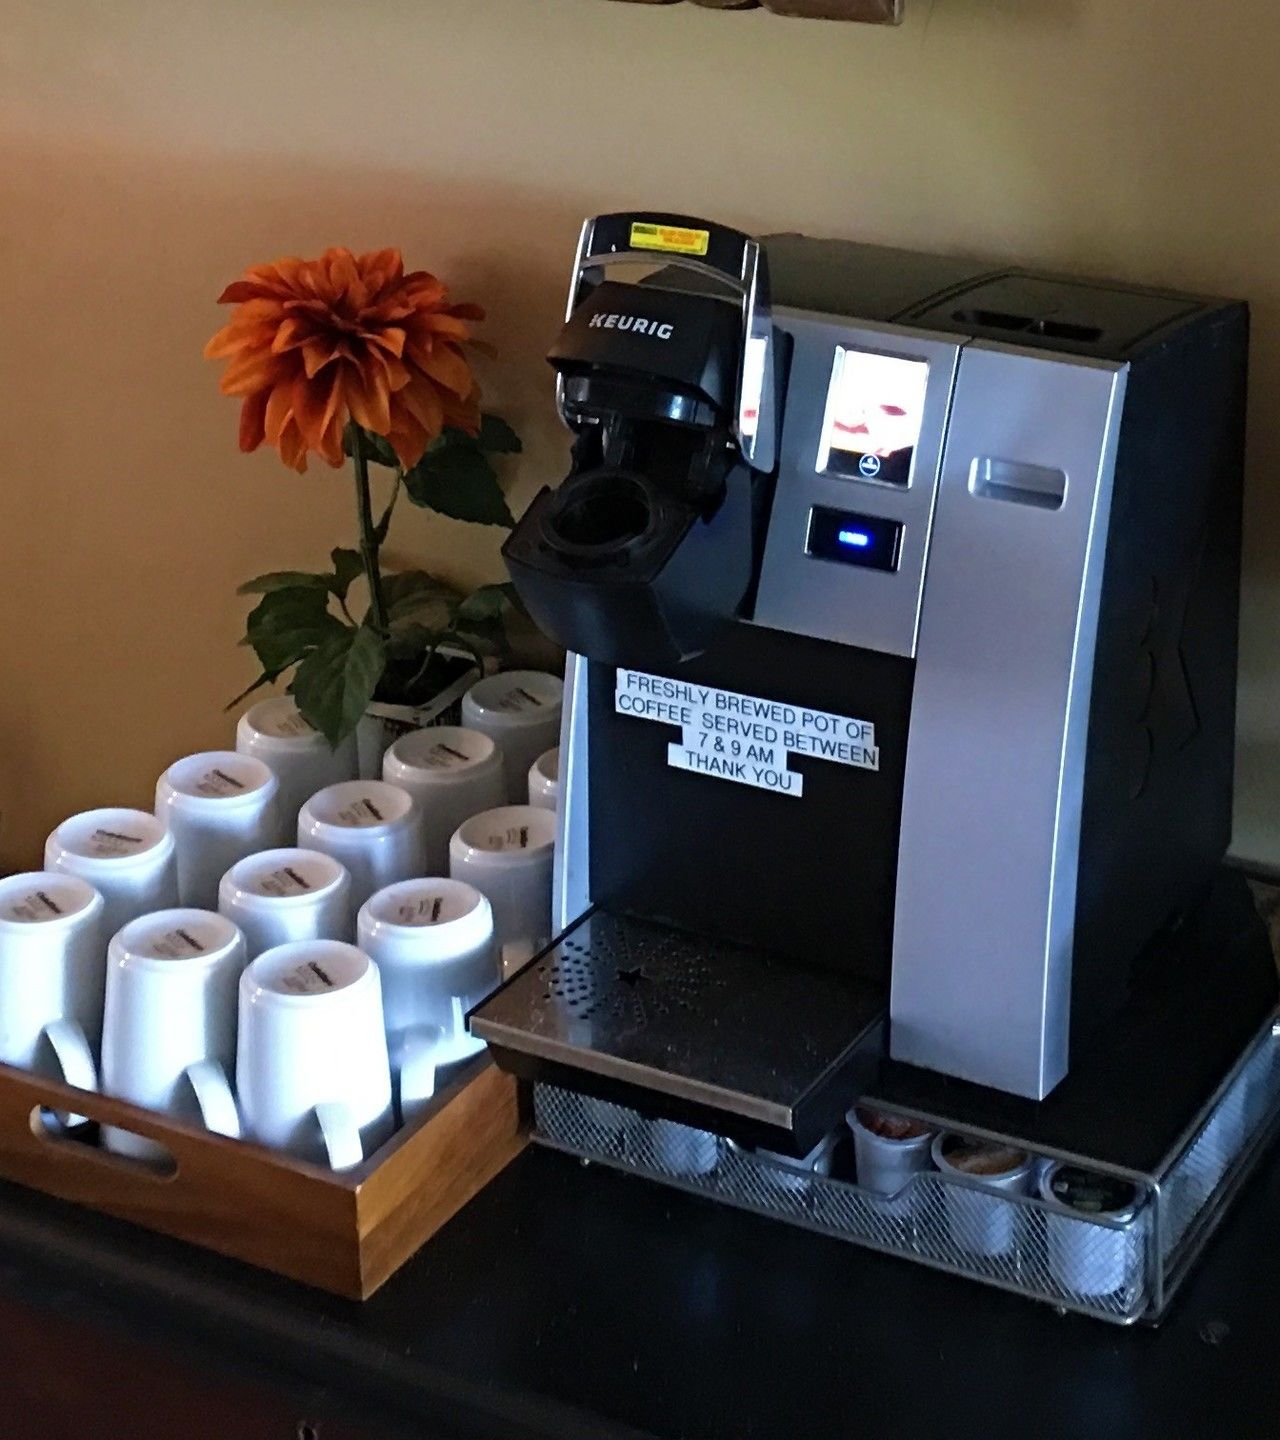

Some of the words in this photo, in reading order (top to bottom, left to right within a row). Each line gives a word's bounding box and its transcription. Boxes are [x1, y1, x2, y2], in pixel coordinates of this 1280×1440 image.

[589, 313, 674, 340] KEURIG
[626, 673, 710, 704] FRESHLY
[715, 694, 796, 725] BREWED
[802, 712, 840, 735] POT
[846, 721, 873, 740] OF
[618, 694, 691, 724] COFFEE
[702, 712, 778, 743] SERVED
[783, 731, 877, 766] BETWEEN
[698, 732, 708, 747] 7
[713, 737, 725, 753] &
[731, 741, 741, 756] 9
[746, 745, 774, 765] AM
[685, 750, 746, 780] THANK
[752, 768, 792, 791] YOU
